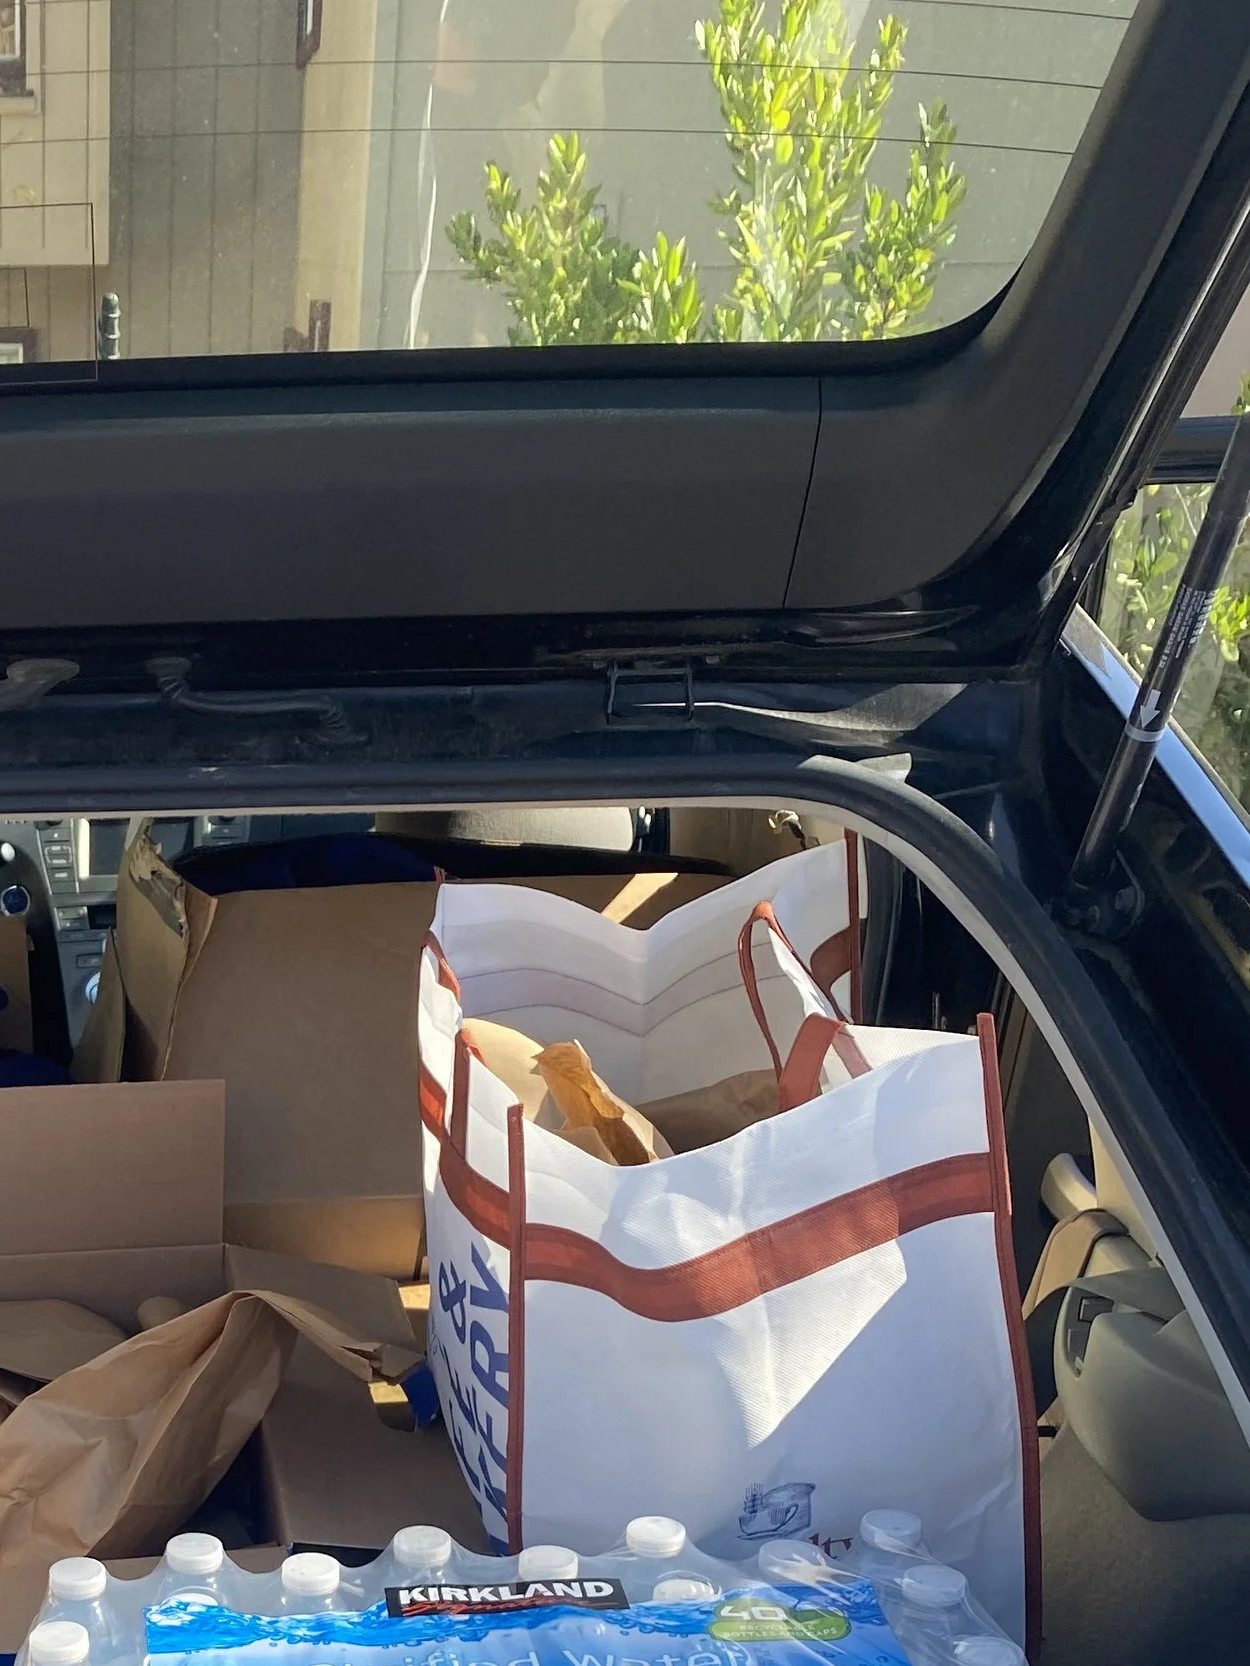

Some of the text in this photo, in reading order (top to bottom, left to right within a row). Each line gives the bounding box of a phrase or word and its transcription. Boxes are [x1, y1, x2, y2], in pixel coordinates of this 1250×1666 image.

[438, 1260, 467, 1345] &
[399, 1581, 614, 1605] KIRKLAND
[721, 1606, 787, 1620] 40
